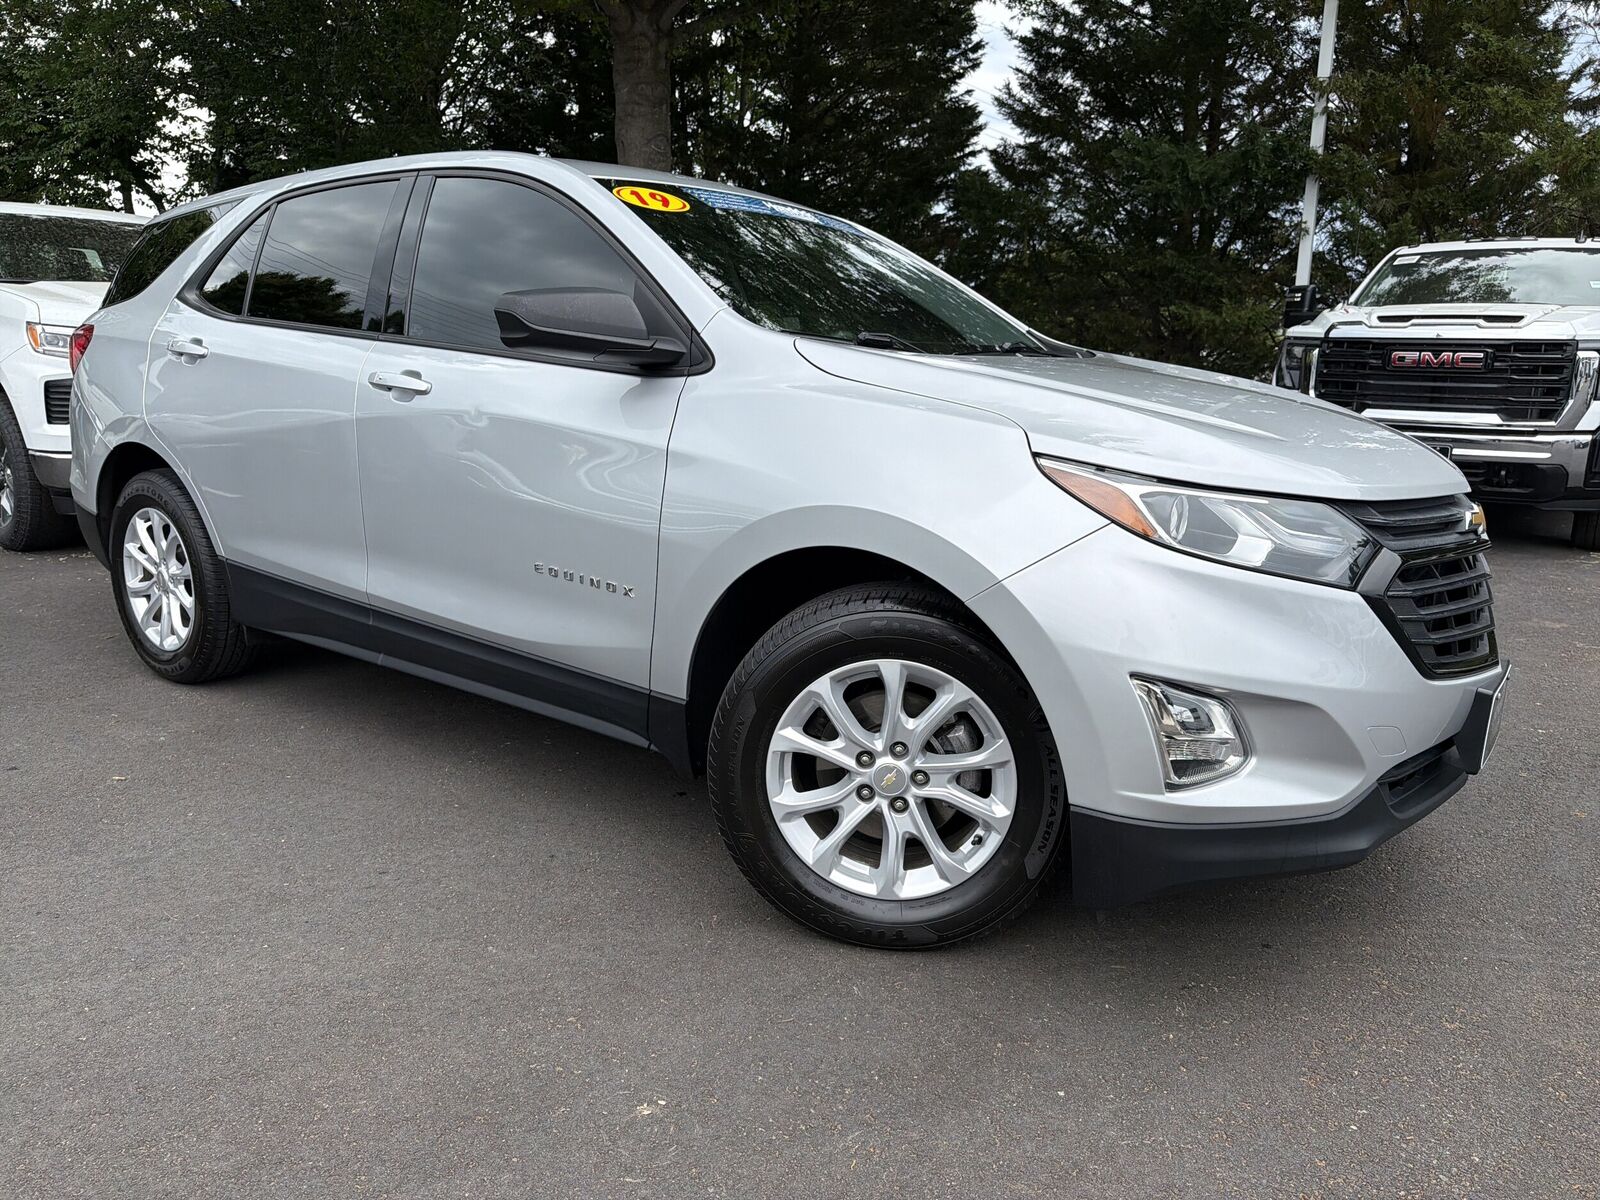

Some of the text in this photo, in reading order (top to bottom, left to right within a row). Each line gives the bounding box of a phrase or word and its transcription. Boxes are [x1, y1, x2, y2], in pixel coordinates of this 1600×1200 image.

[629, 190, 670, 209] 19
[1391, 351, 1485, 369] GMC
[534, 562, 636, 598] EQUINOX
[1036, 744, 1060, 854] ALL SEASON
